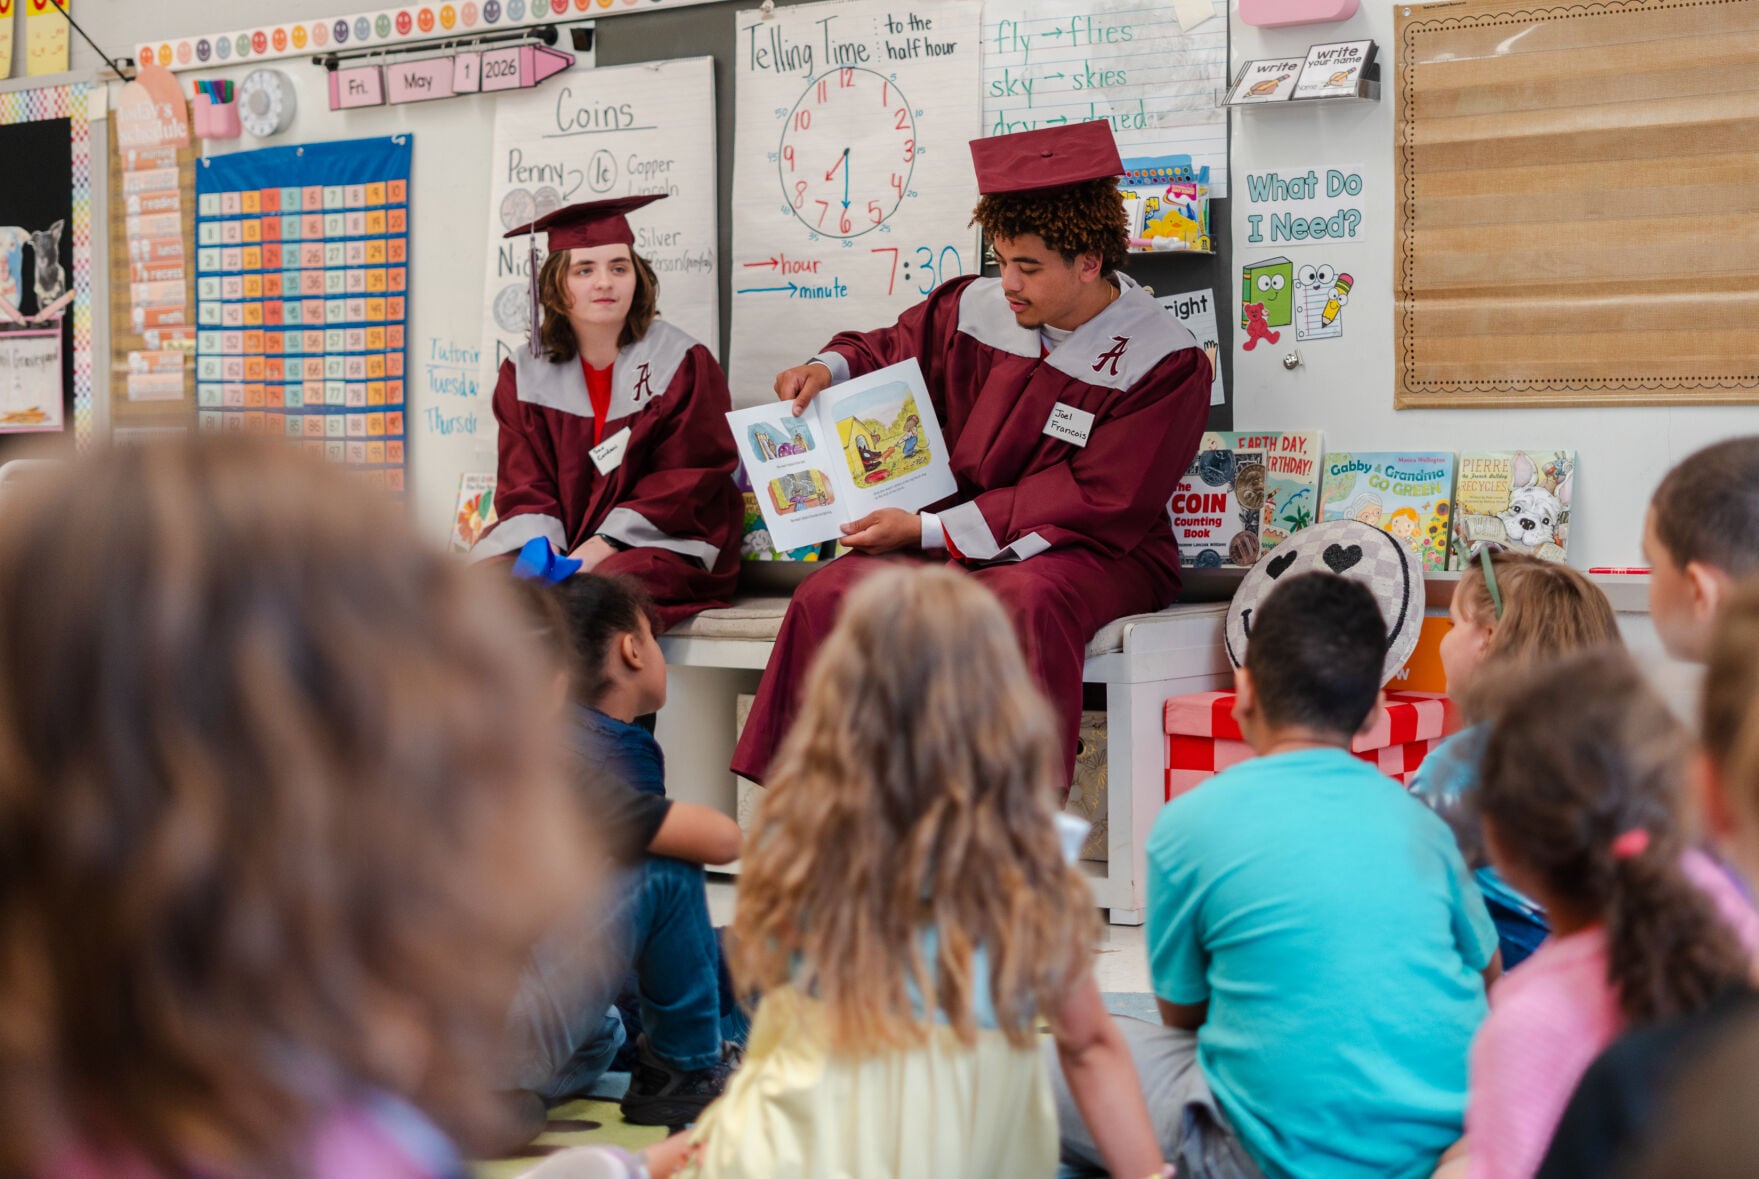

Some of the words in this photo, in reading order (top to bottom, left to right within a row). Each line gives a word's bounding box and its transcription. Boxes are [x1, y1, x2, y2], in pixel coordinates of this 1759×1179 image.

[885, 13, 903, 35] to
[908, 12, 932, 32] the
[742, 22, 813, 78] Telling
[816, 15, 870, 65] Time
[886, 37, 921, 60] half
[924, 36, 958, 57] hour
[993, 19, 1031, 65] fly
[1066, 15, 1133, 47] flies
[1308, 58, 1332, 69] your
[1333, 56, 1362, 66] name
[1317, 46, 1358, 60] write
[348, 79, 368, 95] Fri.
[404, 73, 432, 91] May
[465, 63, 470, 78] 1
[485, 59, 517, 78] 2026
[840, 67, 856, 88] 12
[1257, 62, 1298, 73] write
[817, 80, 827, 104] 11
[882, 80, 887, 107] 1
[989, 68, 1033, 109] sky
[1072, 59, 1127, 90] skies
[557, 87, 634, 132] Coins
[794, 109, 811, 132] 10
[894, 108, 911, 130] 2
[783, 145, 795, 172] 9
[903, 139, 915, 163] 3
[508, 148, 564, 187] Penny
[627, 153, 675, 181] Copper
[794, 180, 807, 210] 8
[891, 173, 902, 200] 4
[1247, 170, 1319, 203] What
[1327, 169, 1362, 198] Do
[815, 200, 829, 228] 7
[840, 208, 852, 234] 6
[868, 200, 882, 224] 5
[1248, 215, 1263, 242] I
[1271, 208, 1361, 242] Need?
[638, 227, 682, 248] Silver
[841, 240, 853, 248] 30
[780, 253, 823, 276] hour
[871, 246, 963, 297] 7:30
[800, 277, 848, 299] minute
[1092, 336, 1130, 376] A
[633, 362, 653, 401] A
[1055, 409, 1072, 420] Joel
[1051, 420, 1087, 440] Francois
[1238, 436, 1277, 452] EARTH
[1282, 436, 1307, 454] DAY,
[1267, 456, 1312, 476] IRTHDAY!
[1331, 460, 1372, 475] Gabby
[1385, 465, 1444, 482] Grandma
[1462, 459, 1509, 473] PIERRE
[1177, 482, 1191, 492] he
[1369, 474, 1390, 491] GO
[1392, 481, 1442, 496] GREEN
[1460, 481, 1507, 492] RECYCLES
[1171, 493, 1227, 514] COIN
[1174, 516, 1222, 528] Counting
[1183, 529, 1210, 538] Book
